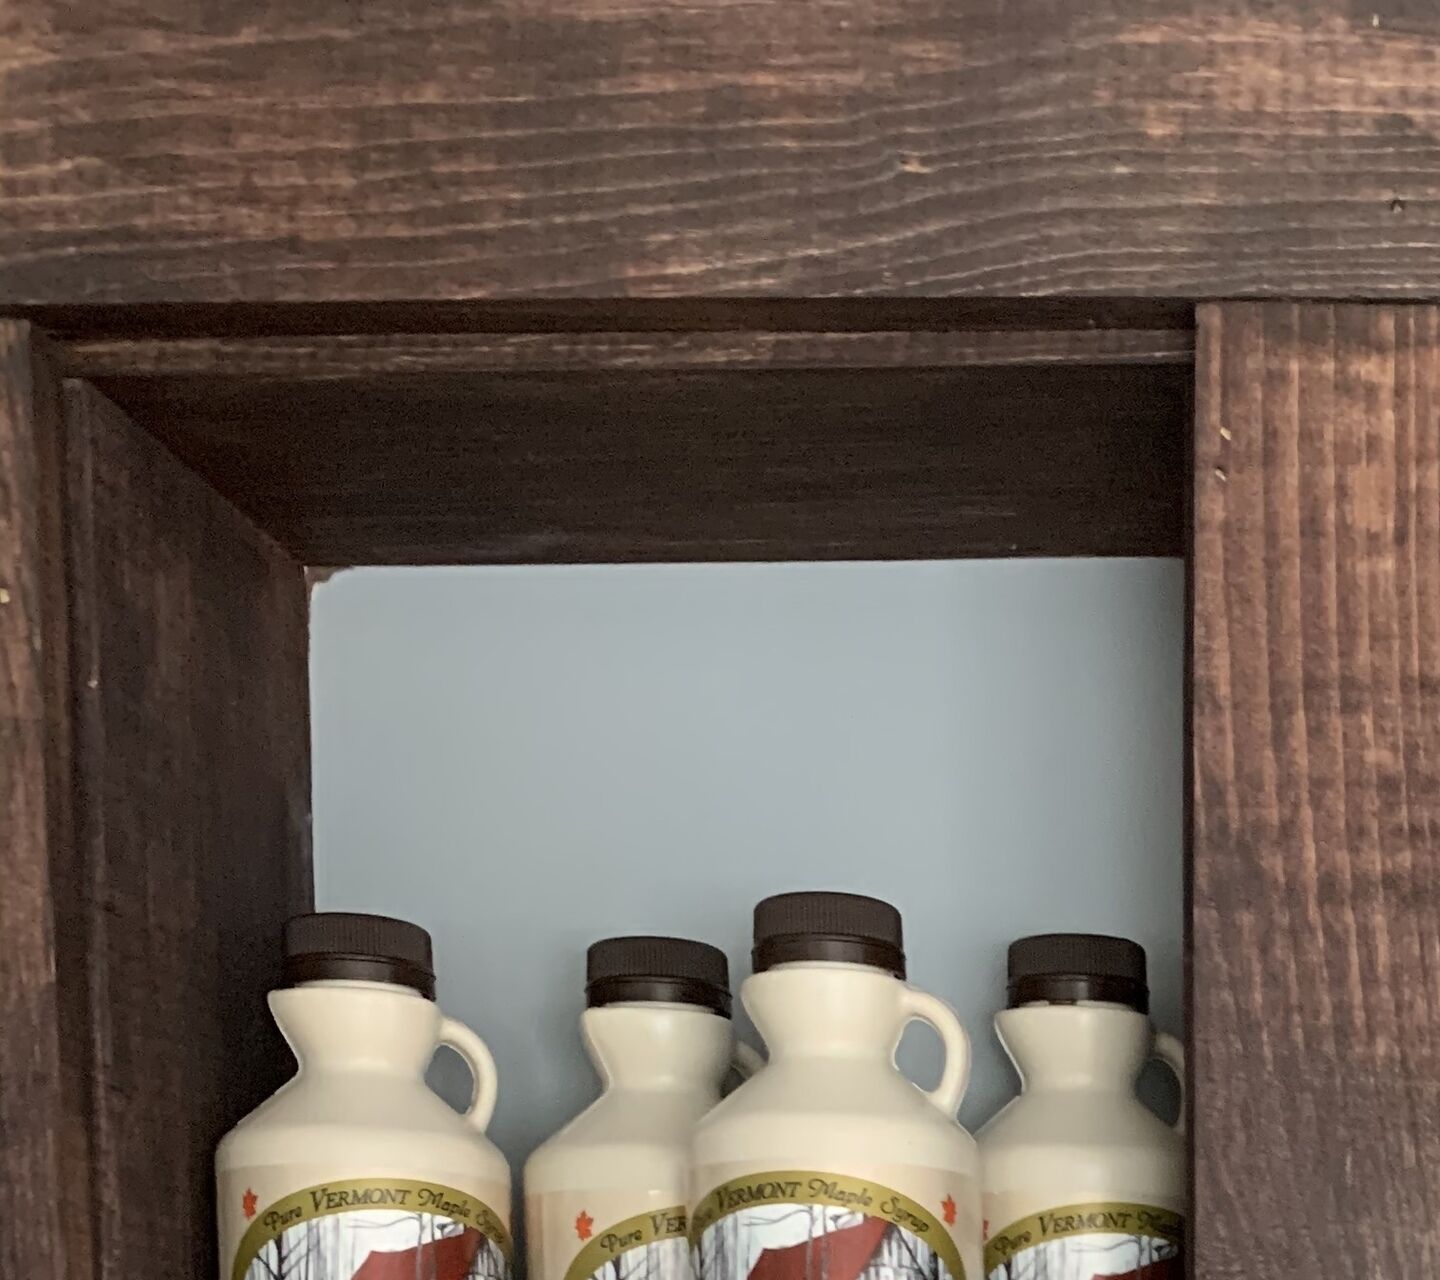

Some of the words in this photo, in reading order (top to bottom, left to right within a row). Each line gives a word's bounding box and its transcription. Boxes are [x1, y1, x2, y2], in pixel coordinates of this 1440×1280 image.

[263, 1206, 302, 1231] Pure
[310, 1187, 413, 1212] VERMONT
[418, 1188, 472, 1220] Maple
[717, 1181, 803, 1211] VERMONT
[808, 1178, 873, 1207] Maple
[1038, 1211, 1132, 1237] VERMONT
[600, 1230, 642, 1253] Pure
